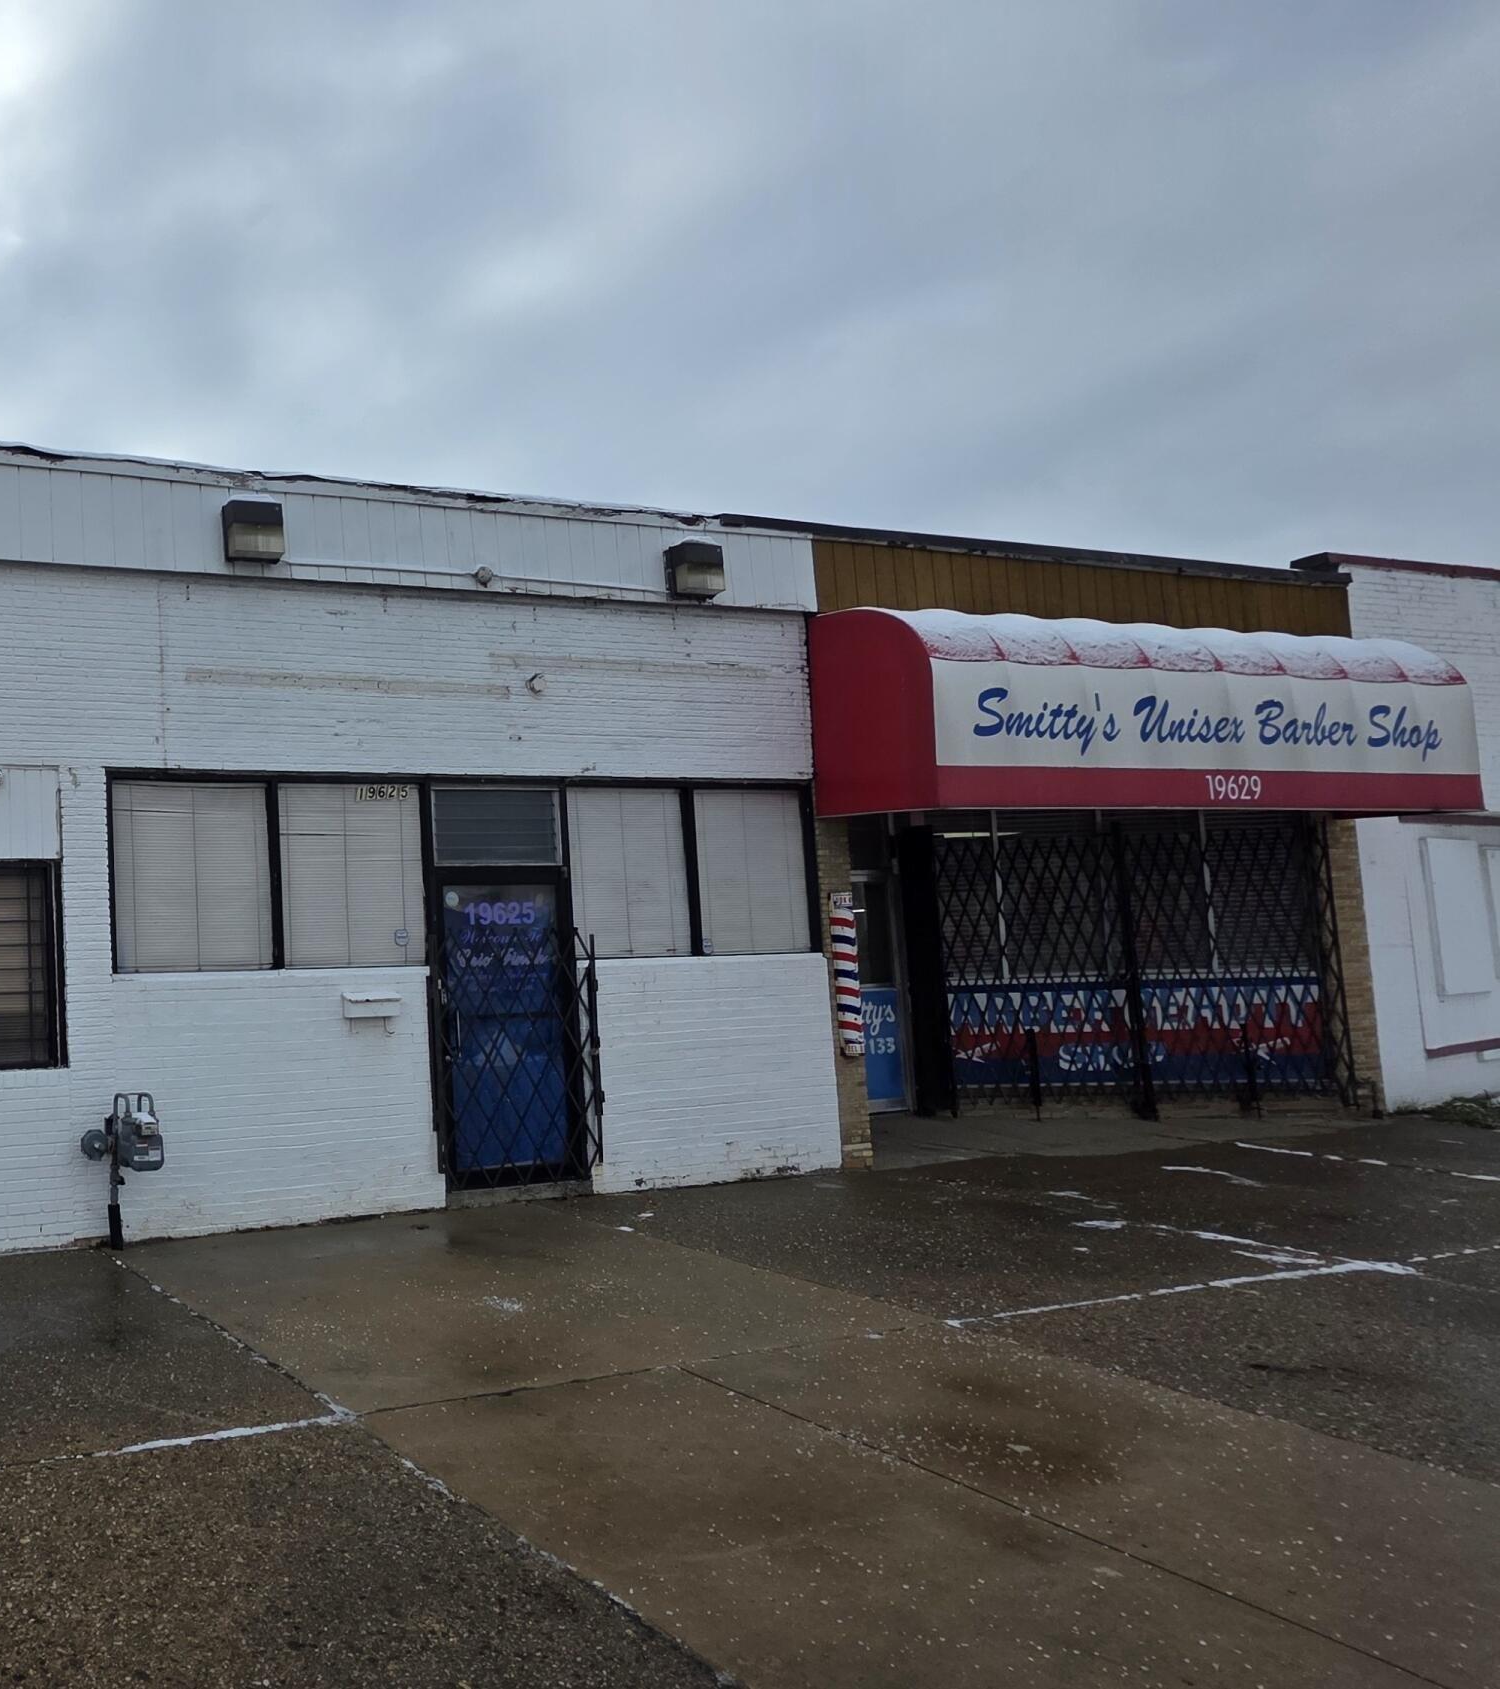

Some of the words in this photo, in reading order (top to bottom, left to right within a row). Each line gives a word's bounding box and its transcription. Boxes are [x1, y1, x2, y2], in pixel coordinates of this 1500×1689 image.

[973, 687, 1121, 756] Smitty's
[1133, 695, 1246, 744] Unisex
[1254, 699, 1357, 746] Barber
[1367, 705, 1443, 762] Shop
[358, 785, 408, 800] 19625
[1205, 775, 1261, 800] 19629
[464, 902, 535, 925] 19625
